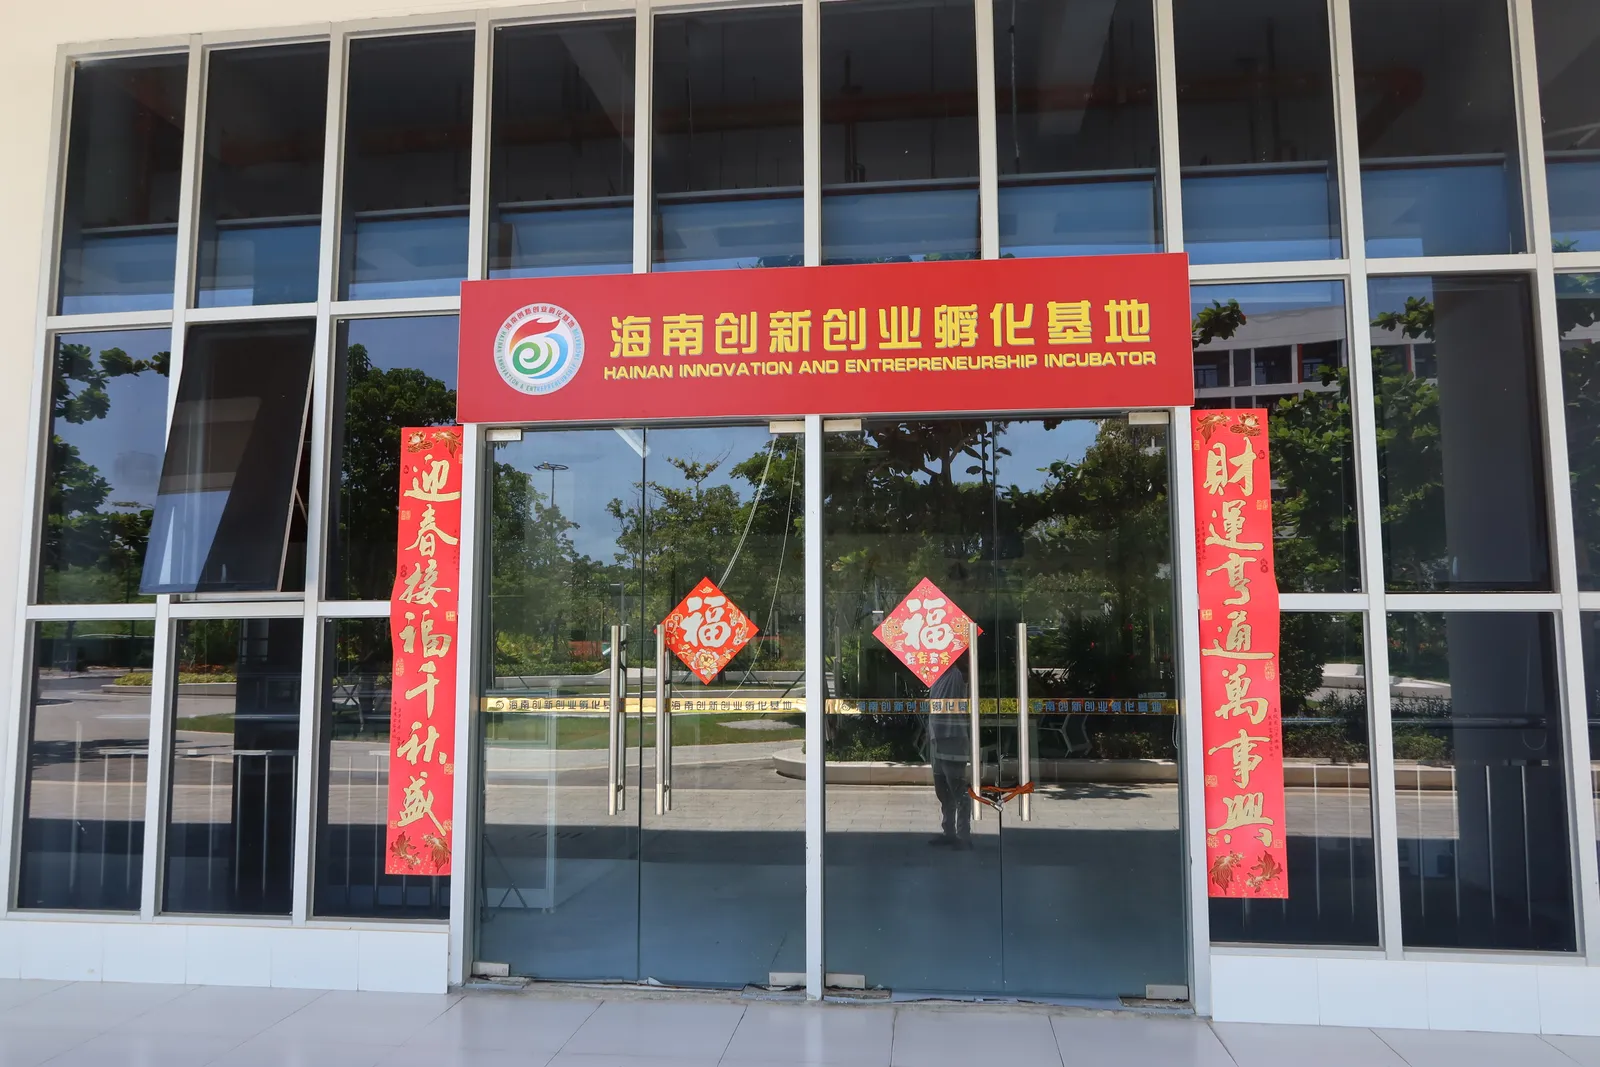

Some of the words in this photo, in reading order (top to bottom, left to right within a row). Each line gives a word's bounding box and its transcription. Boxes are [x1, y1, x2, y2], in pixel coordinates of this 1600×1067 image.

[610, 299, 1151, 358] 海南创新创业孵化基地
[604, 365, 674, 380] HAINAN
[679, 361, 793, 378] INNOVATION
[799, 359, 839, 375] AND
[845, 354, 1038, 374] ENTREPRENEURSHIP
[1044, 351, 1156, 368] INCUBATOR
[680, 595, 732, 648] 福
[902, 597, 955, 651] 福
[397, 453, 461, 837] 迎春接福千秋盛
[509, 700, 624, 710] 海南创新创业孵化基
[671, 700, 792, 711] 海南创新创业孵化基地
[857, 701, 969, 712] 海南创新创业孵化基
